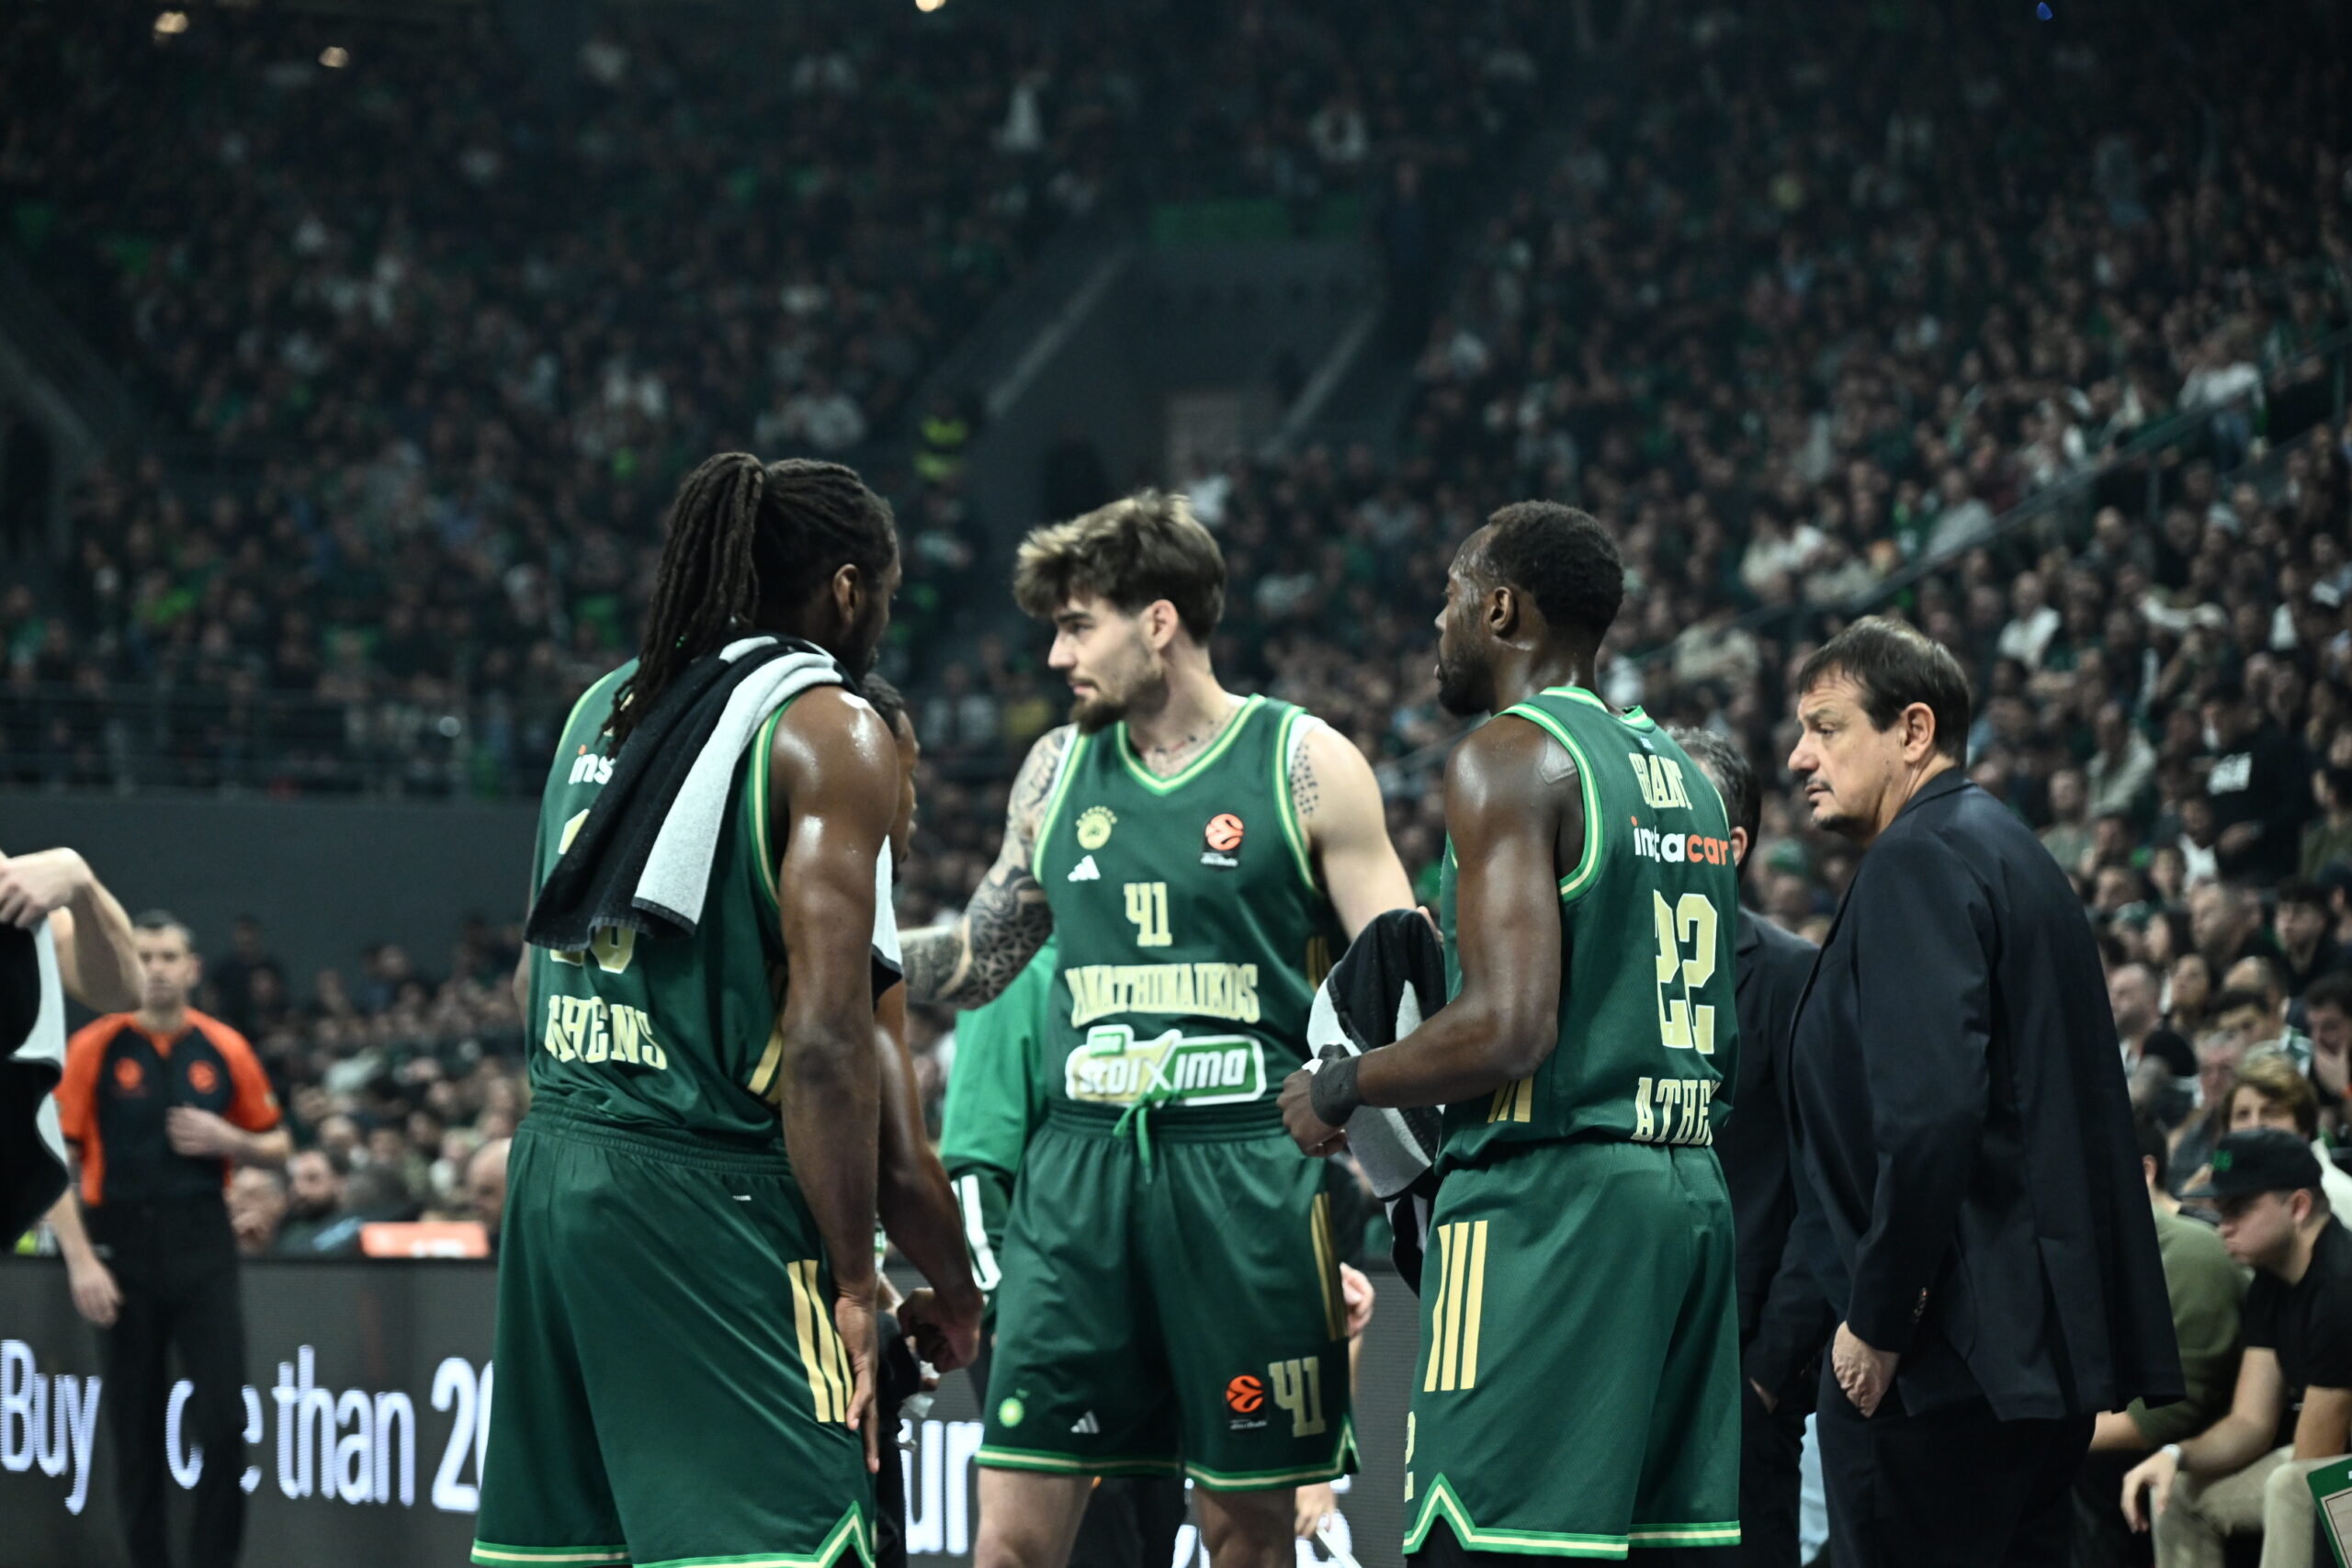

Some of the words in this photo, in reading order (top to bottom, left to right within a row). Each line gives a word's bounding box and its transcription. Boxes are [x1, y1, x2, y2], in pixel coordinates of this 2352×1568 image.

[568, 744, 616, 785] ins
[1631, 816, 1729, 865] intacar
[1124, 882, 1172, 947] 41
[1654, 889, 1717, 1055] 22
[1630, 1077, 1720, 1146] ATHE
[0, 1340, 101, 1515] Buy
[272, 1344, 415, 1506] than
[1269, 1356, 1326, 1438] 41
